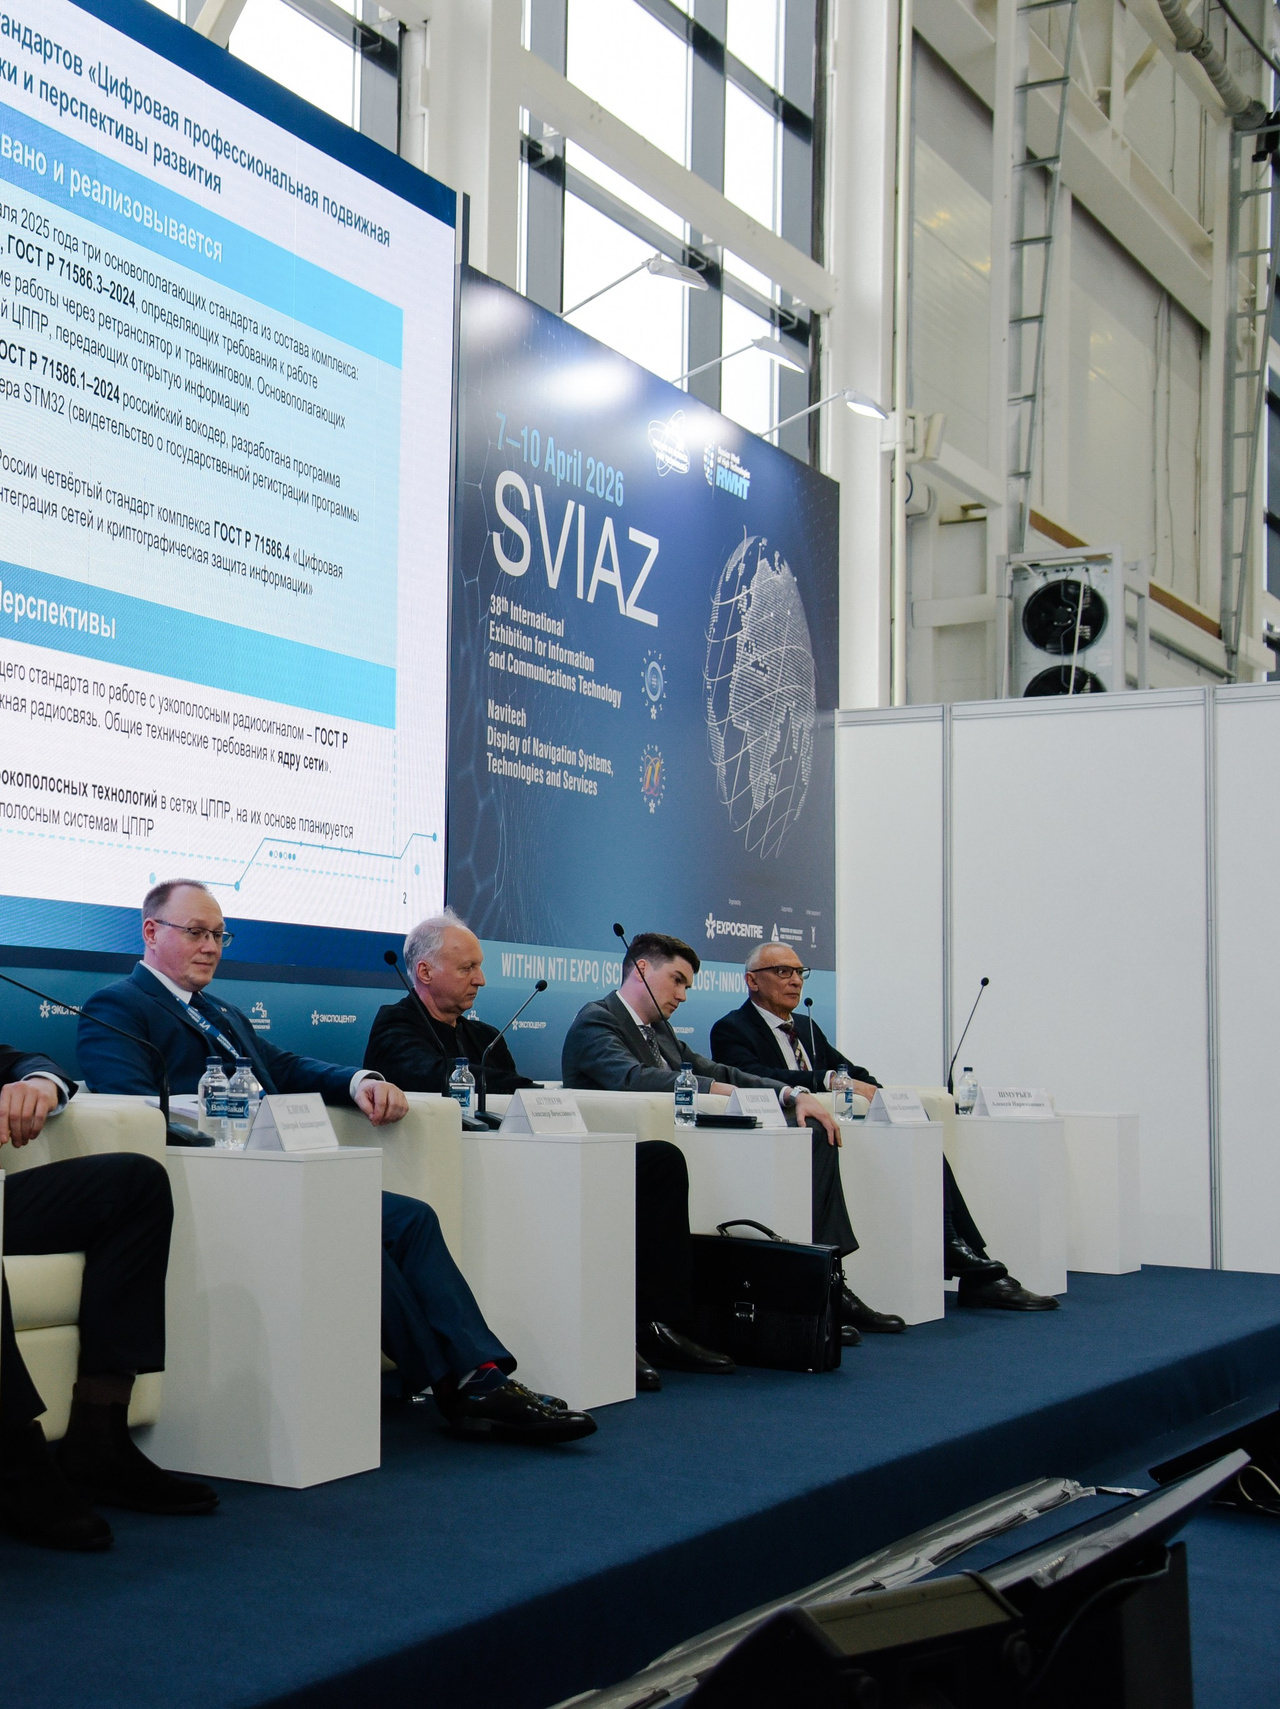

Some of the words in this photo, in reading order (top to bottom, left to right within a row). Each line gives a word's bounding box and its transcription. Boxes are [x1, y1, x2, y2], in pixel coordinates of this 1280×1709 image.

[23, 70, 34, 94] и
[39, 79, 148, 156] перспективы
[153, 141, 222, 195] развития
[88, 61, 179, 132] «Цифровая
[183, 116, 319, 209] профессиональная
[322, 195, 391, 248] подвижная
[53, 159, 65, 186] и
[69, 167, 222, 264] реализовывается
[7, 233, 44, 268] ГОСТ
[141, 299, 220, 347] определяющих
[221, 334, 278, 372] требования
[279, 361, 285, 375] к
[286, 363, 318, 390] работе
[20, 207, 50, 240] 2025
[53, 227, 79, 254] года
[81, 240, 102, 264] три
[104, 251, 207, 312] основополагающих
[208, 300, 259, 336] стандарта
[261, 324, 272, 342] из
[273, 330, 310, 359] состава
[122, 392, 183, 428] российский
[185, 416, 229, 449] вокодер,
[231, 434, 291, 470] разработана
[292, 458, 341, 489] программа
[544, 436, 582, 488] April
[585, 456, 624, 507] 2026
[716, 464, 750, 500] RWHT
[493, 470, 659, 627] SVIAZ
[490, 594, 509, 617] 38th
[510, 600, 564, 638] International
[489, 621, 533, 653] Exhibition
[534, 633, 547, 656] for
[548, 636, 595, 672] Information
[28, 667, 90, 696] стандарта
[92, 680, 106, 699] по
[108, 682, 147, 707] работе
[149, 693, 156, 709] с
[158, 696, 231, 725] узкополосным
[232, 712, 304, 741] радиосигналом
[314, 726, 340, 748] ГОСТ
[488, 650, 506, 670] and
[507, 655, 577, 693] Communications
[578, 673, 622, 709] Technology
[487, 699, 527, 729] Navitech
[486, 752, 544, 785] Technologies
[546, 766, 561, 788] and
[563, 771, 598, 797] Services
[487, 725, 521, 755] Display
[522, 735, 531, 755] of
[532, 738, 577, 770] Navigation
[578, 750, 615, 778] Systems,
[91, 783, 158, 809] технологий
[160, 795, 167, 810] в
[169, 796, 198, 815] сетях
[200, 797, 233, 822] ЦППР,
[236, 808, 248, 823] на
[250, 810, 262, 825] их
[263, 812, 297, 831] основе
[298, 817, 354, 841] планируется
[402, 891, 407, 905] 2
[716, 921, 763, 939] EXPOCENTRE
[501, 953, 548, 980] WITHIN
[548, 958, 567, 982] NTI
[570, 959, 600, 984] EXPO
[320, 1014, 357, 1024] ЭКСПОЦЕНТР
